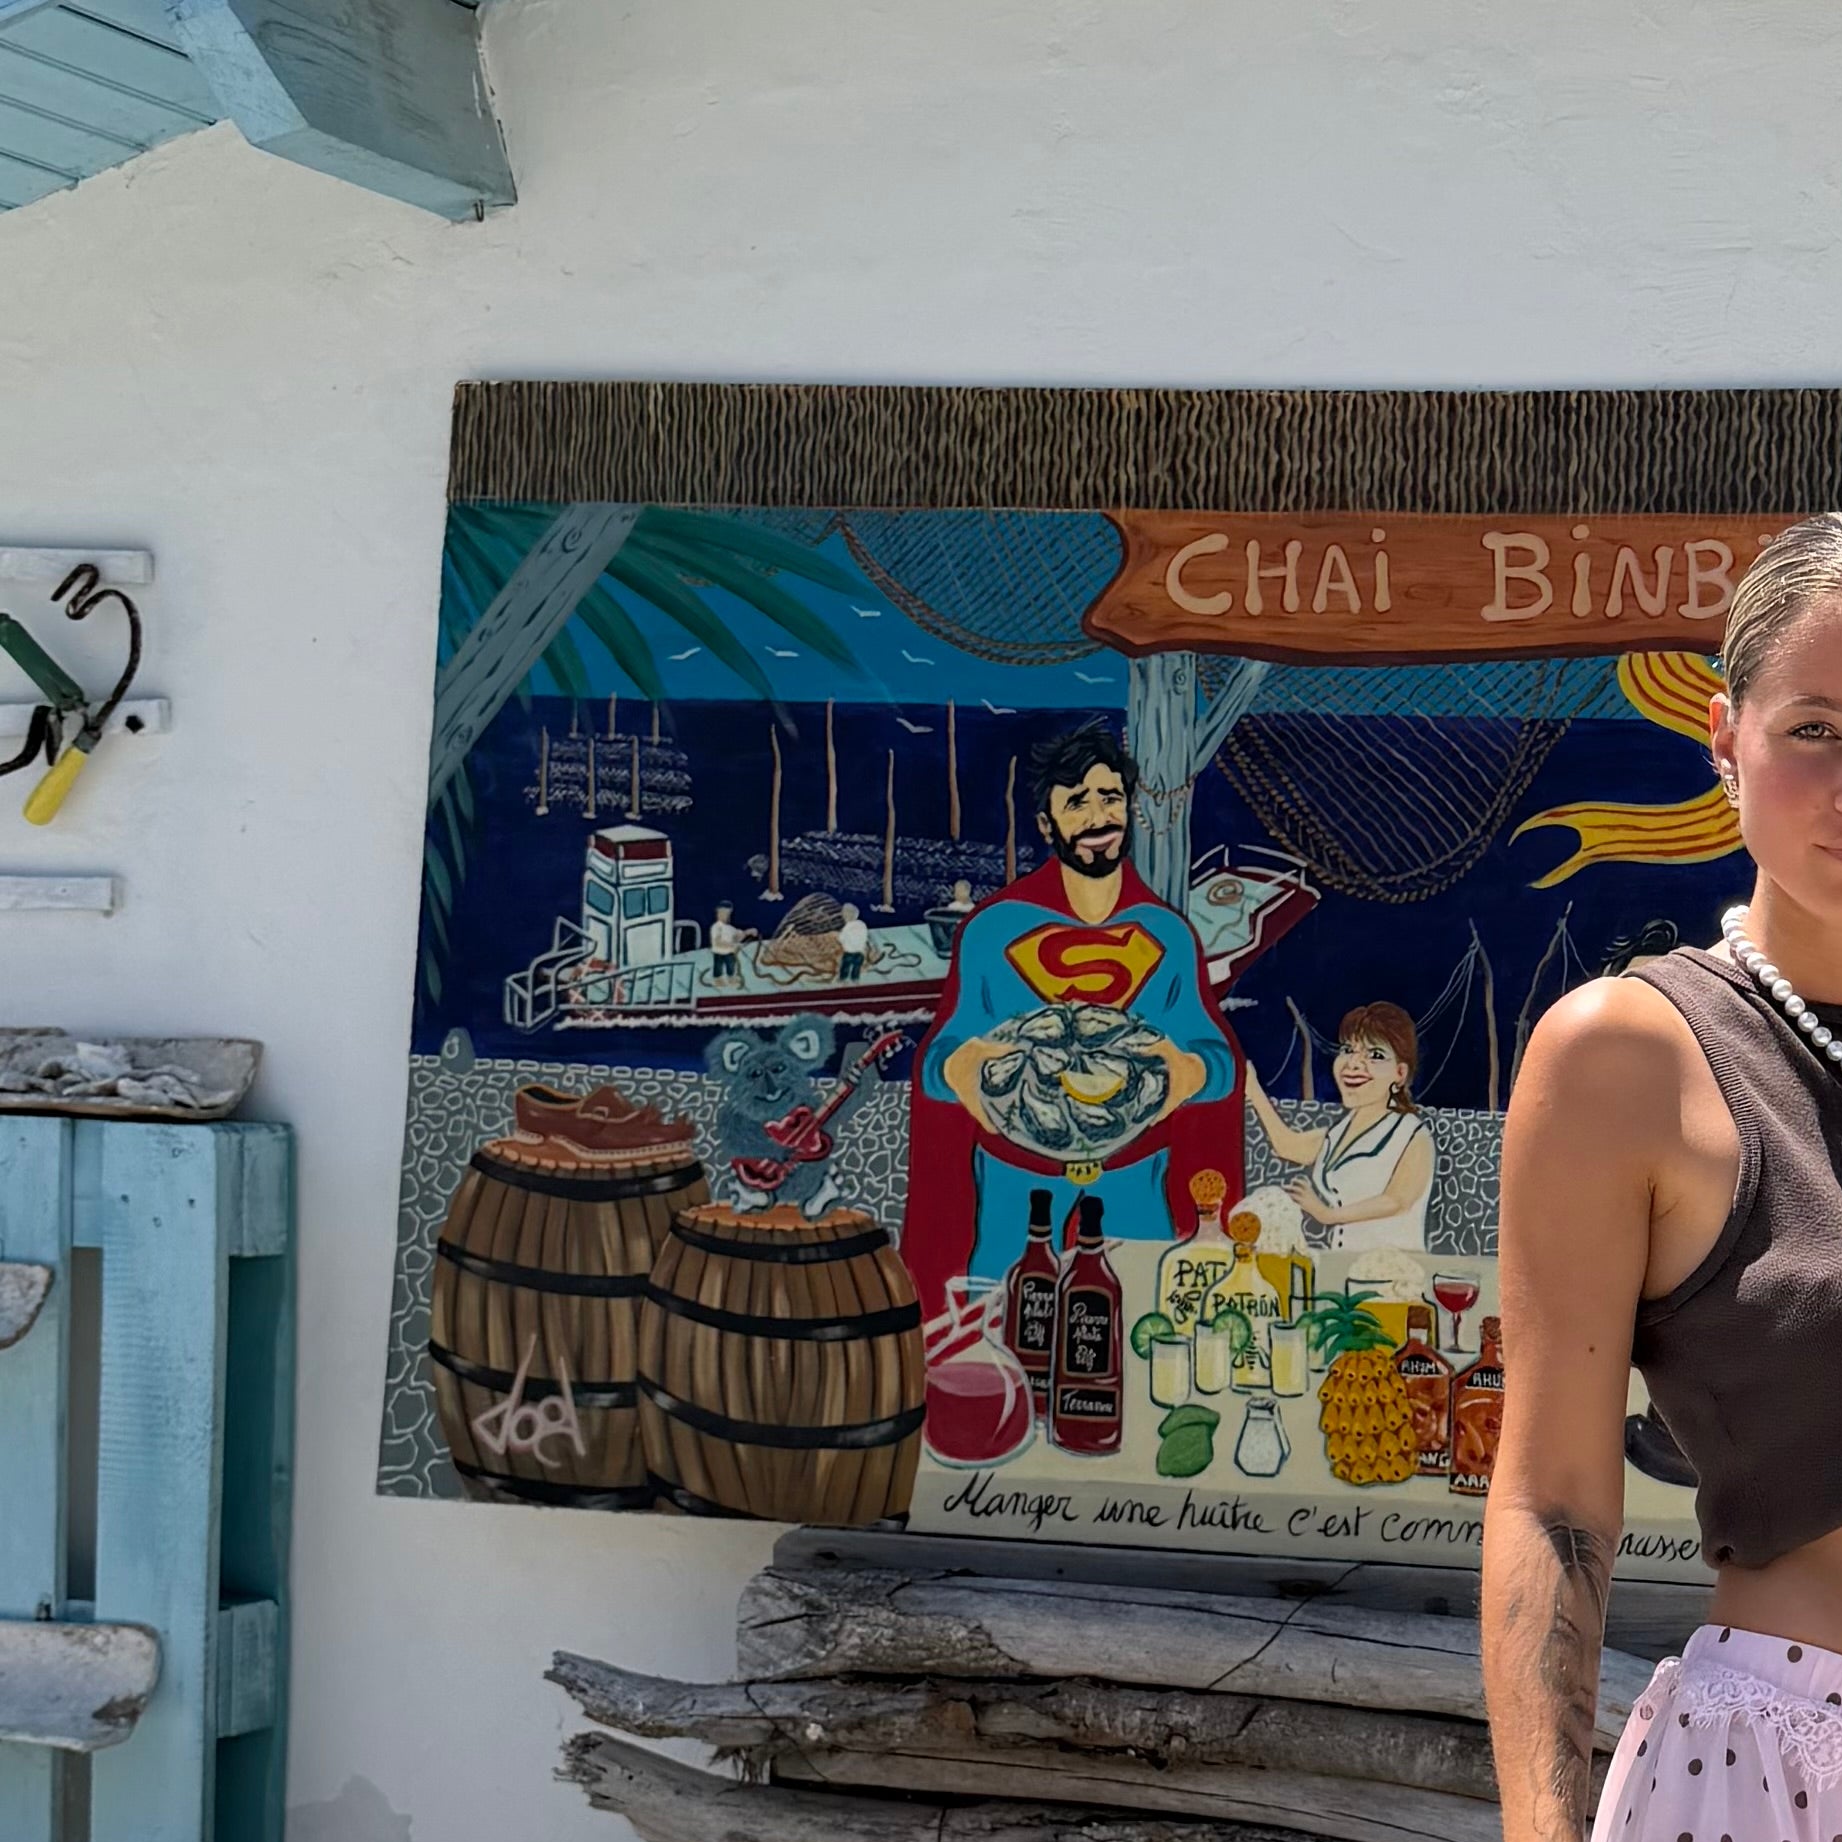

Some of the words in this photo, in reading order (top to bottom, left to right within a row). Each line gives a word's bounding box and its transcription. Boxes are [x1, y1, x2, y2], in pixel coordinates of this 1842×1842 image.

[1173, 1259, 1228, 1287] PAT
[1472, 1372, 1505, 1387] RHU
[943, 1471, 1080, 1533] Manger
[1092, 1496, 1171, 1527] une
[1380, 1513, 1484, 1546] comm
